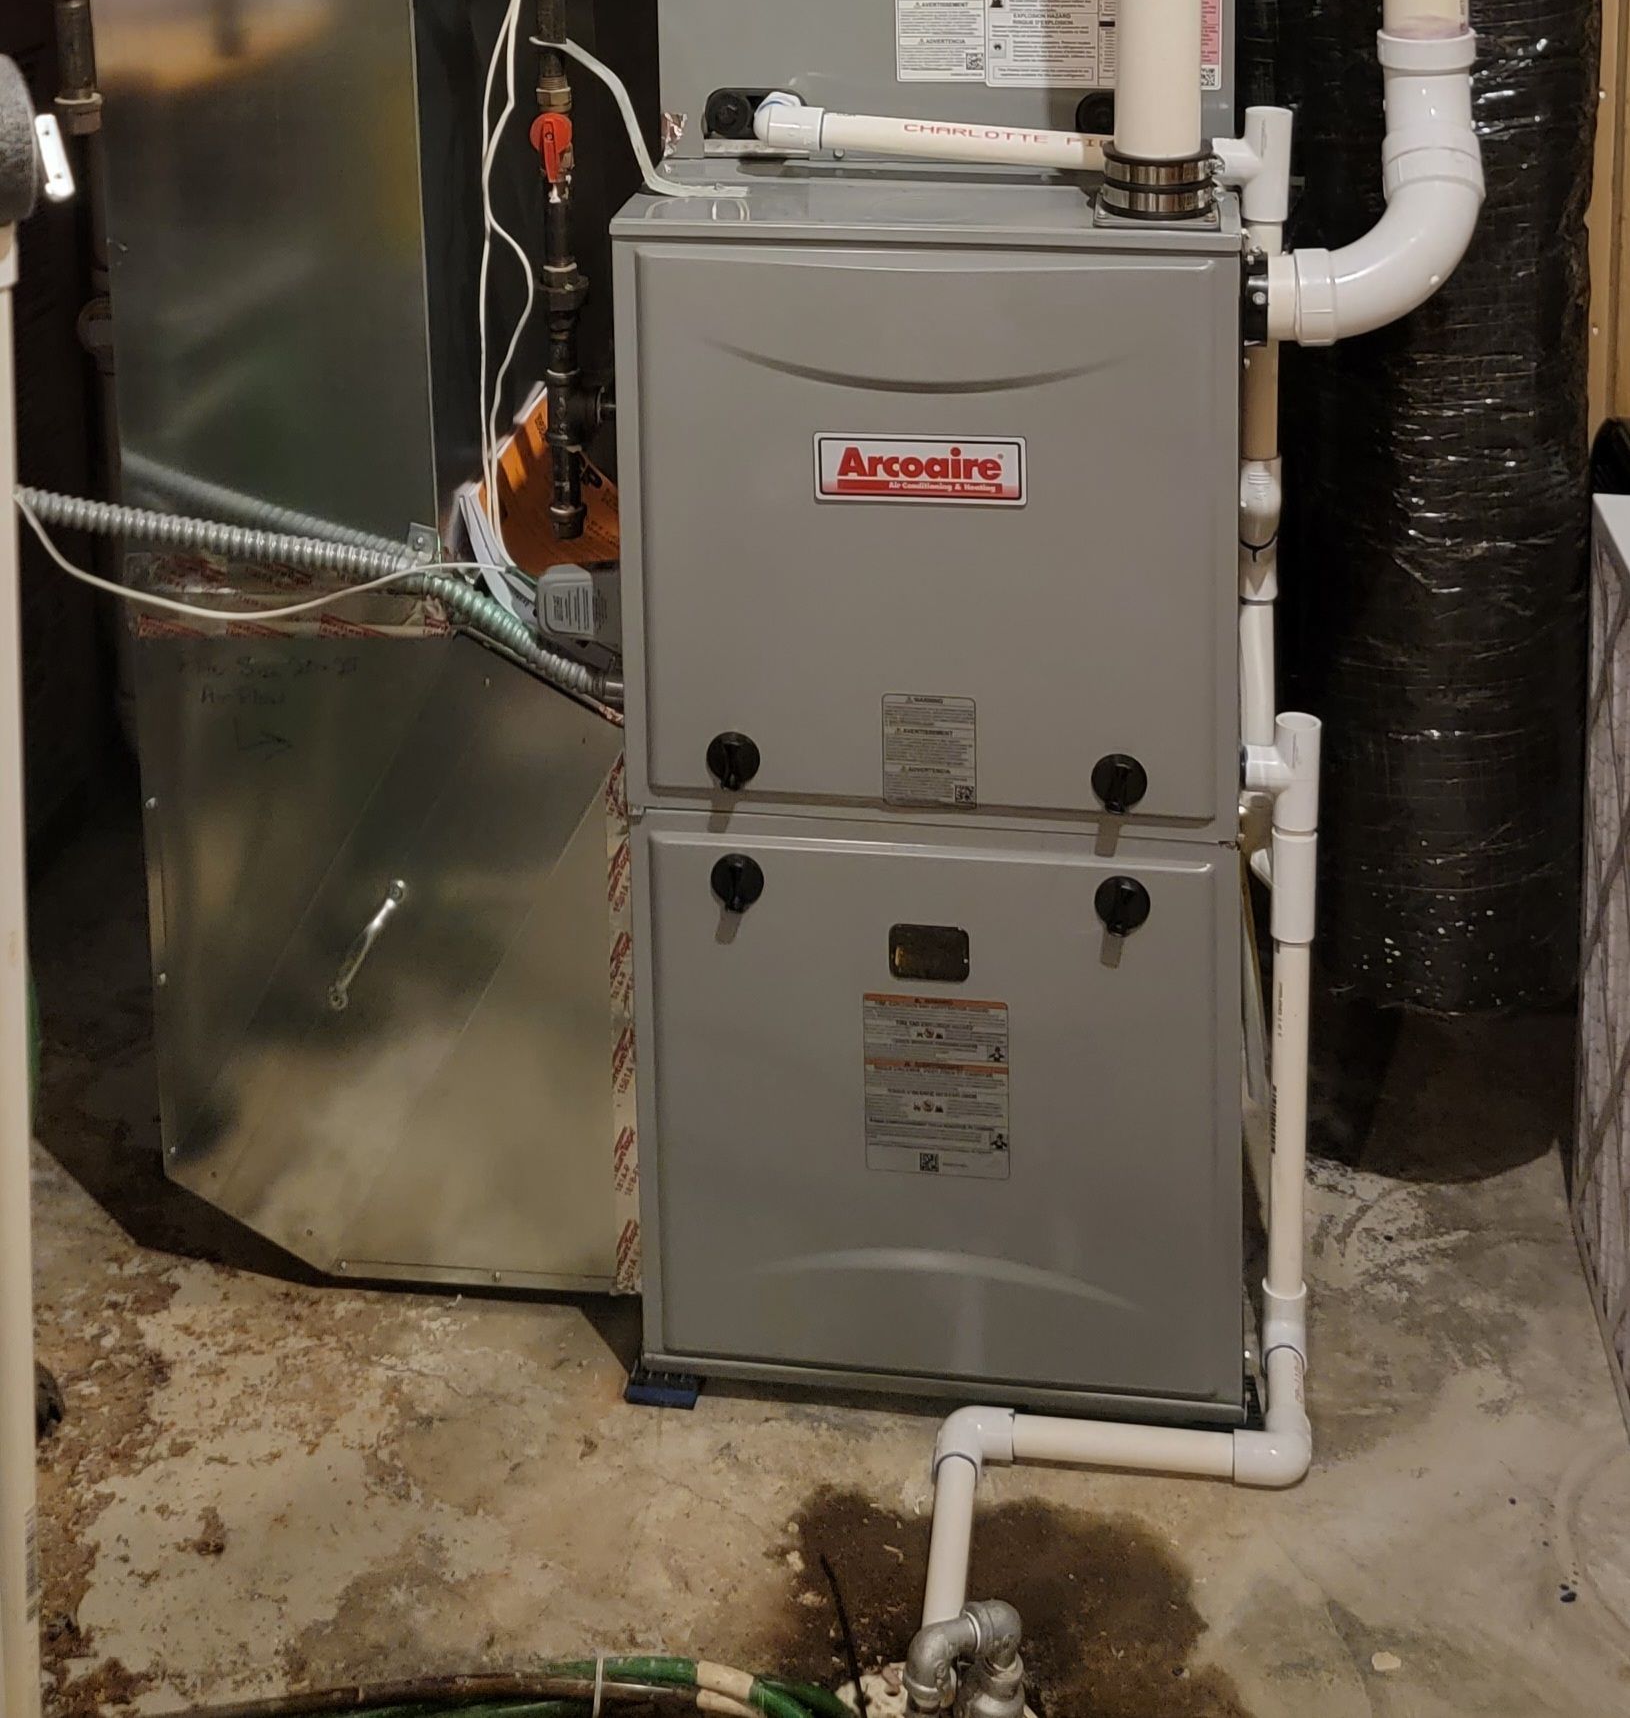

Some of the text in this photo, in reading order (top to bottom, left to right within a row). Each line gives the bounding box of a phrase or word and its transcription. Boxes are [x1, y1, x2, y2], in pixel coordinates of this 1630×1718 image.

[904, 123, 1049, 144] CHARLOTTE
[837, 446, 1002, 481] Arcoaire
[902, 482, 952, 492] Conditioning
[964, 484, 996, 493] Heating
